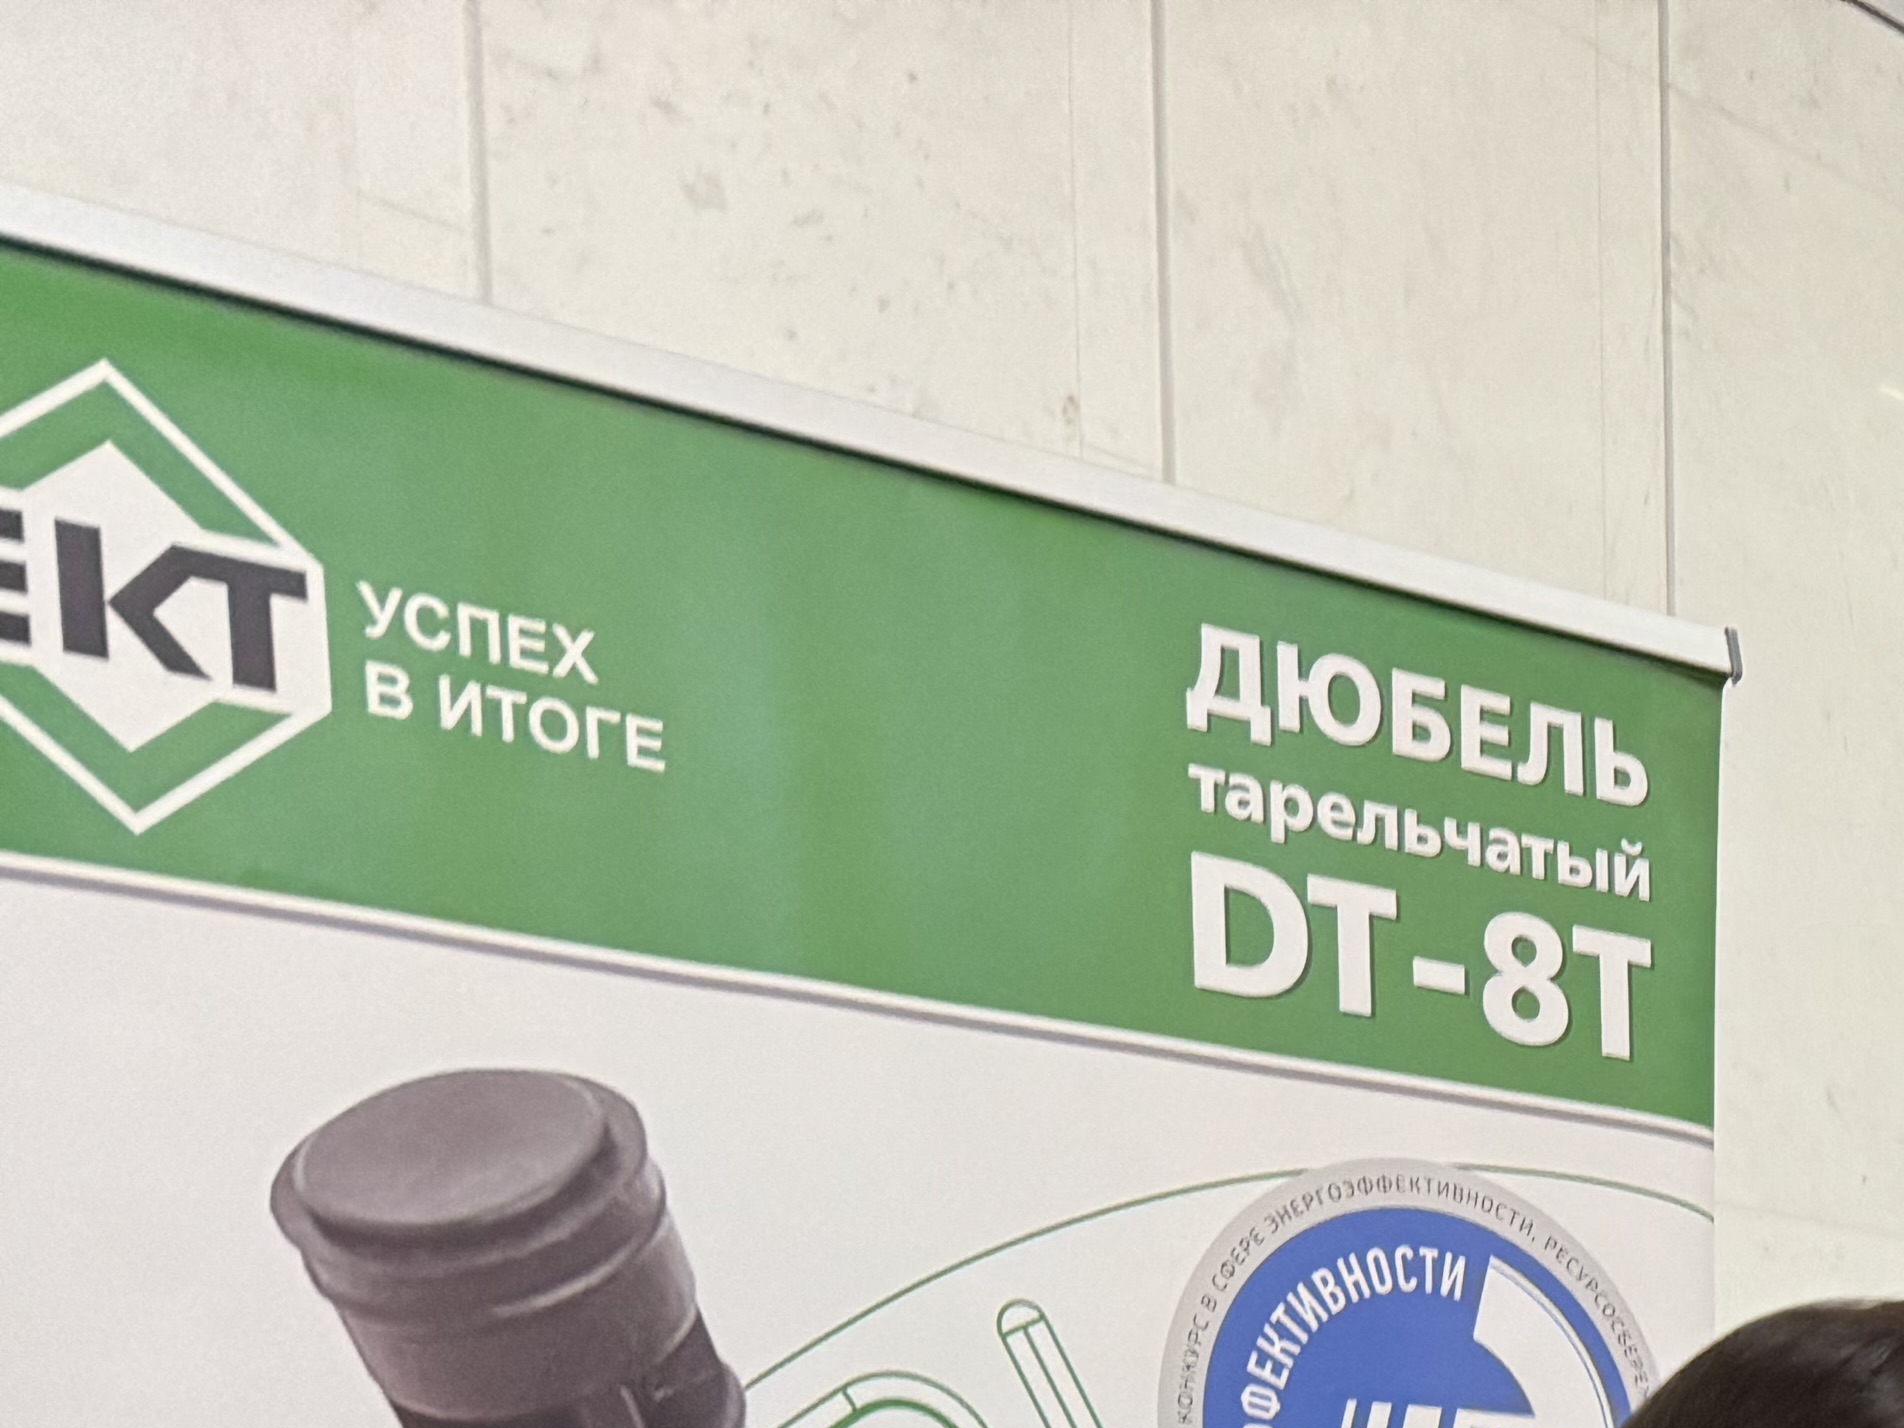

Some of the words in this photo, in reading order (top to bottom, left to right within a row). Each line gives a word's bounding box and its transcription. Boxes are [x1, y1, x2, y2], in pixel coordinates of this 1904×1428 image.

[357, 581, 600, 685] УСПЕХ
[365, 661, 413, 720] В
[438, 676, 668, 773] ИТОГЕ
[1186, 622, 1650, 808] ДЮБЕЛЬ
[1187, 762, 1653, 902] тарельчатый
[1190, 850, 1653, 1062] DT-8T
